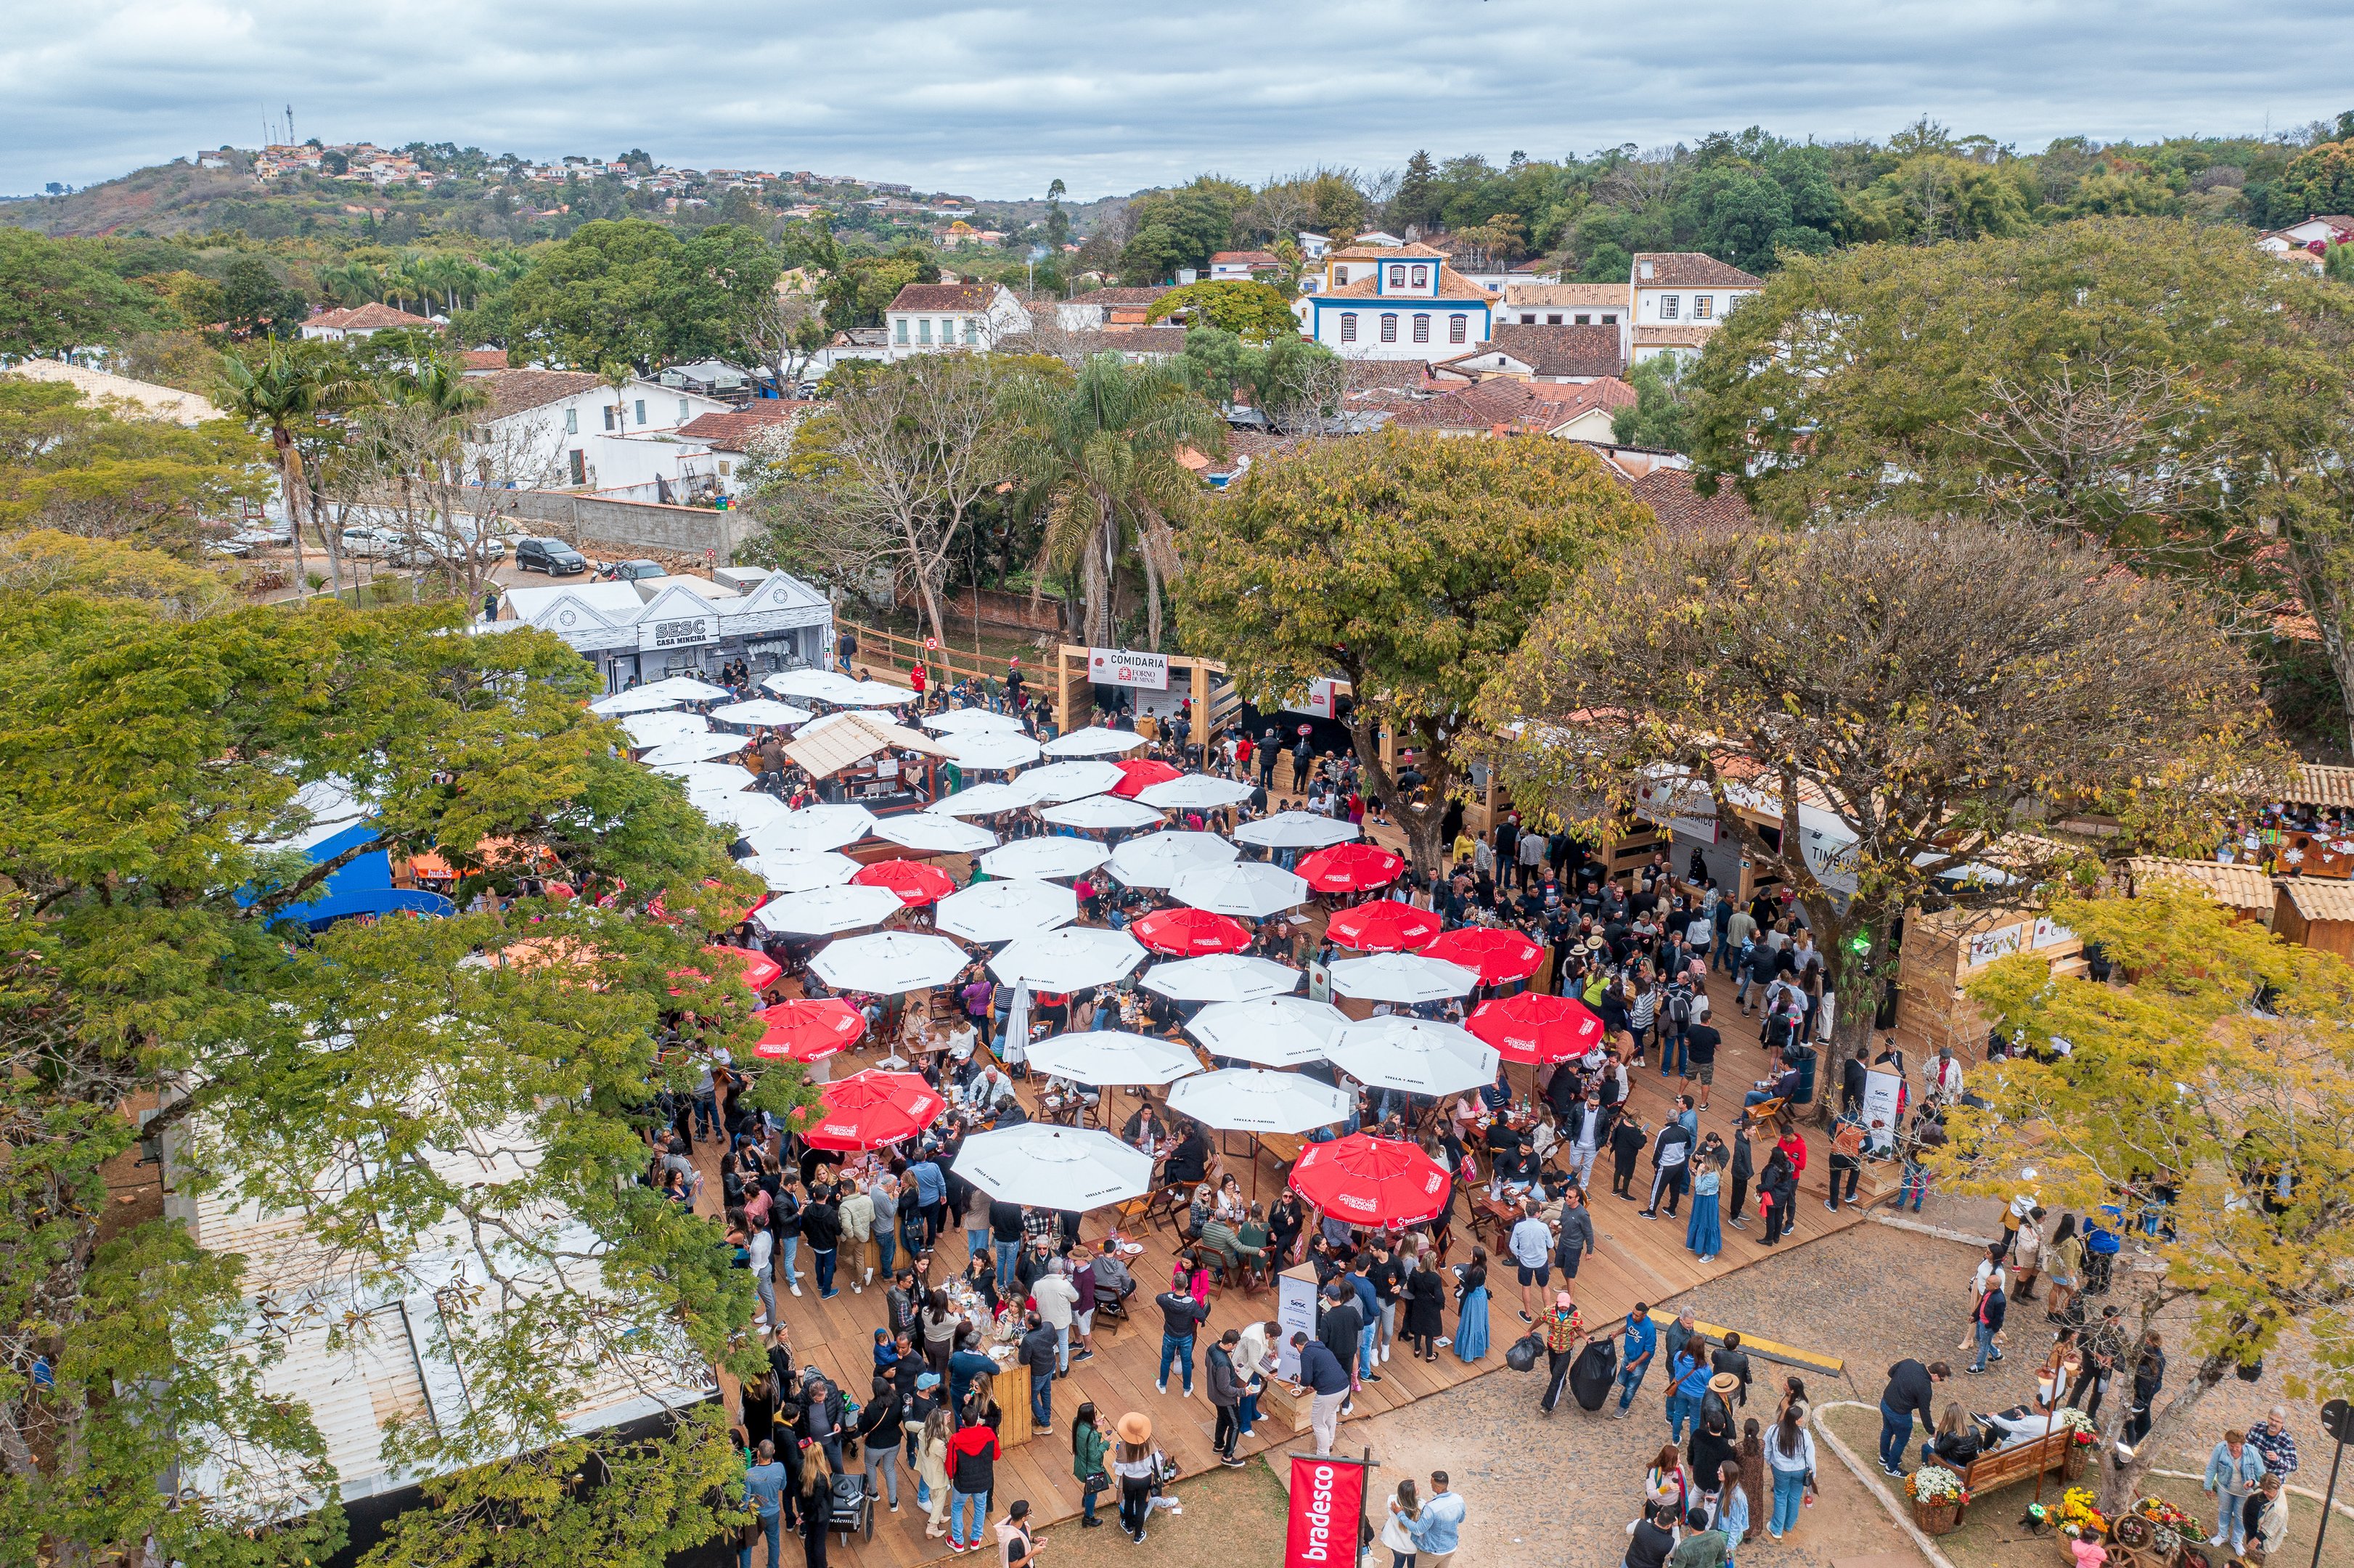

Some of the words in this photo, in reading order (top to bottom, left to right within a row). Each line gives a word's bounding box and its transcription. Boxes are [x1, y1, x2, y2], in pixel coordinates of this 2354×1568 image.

[655, 619, 706, 639] SESC
[677, 635, 706, 644] MINEIRA
[1111, 655, 1164, 669] COMIDARIA
[1504, 973, 1523, 982] bradesco
[1504, 1038, 1534, 1049] GASTRONOMIA
[815, 1048, 838, 1059] bradesco
[1560, 1052, 1581, 1061] bradesco
[883, 1132, 908, 1145] bradesco
[1465, 1156, 1474, 1175] CAIXA
[974, 1167, 986, 1177] STELLA
[988, 1177, 1000, 1186] ARTOIS
[1339, 1196, 1376, 1208] GASTRONOMIA
[1349, 1202, 1376, 1212] TIRADENTES
[1405, 1214, 1427, 1225] bradesco
[1291, 1299, 1306, 1308] sesc
[1301, 1466, 1334, 1561] bradesco
